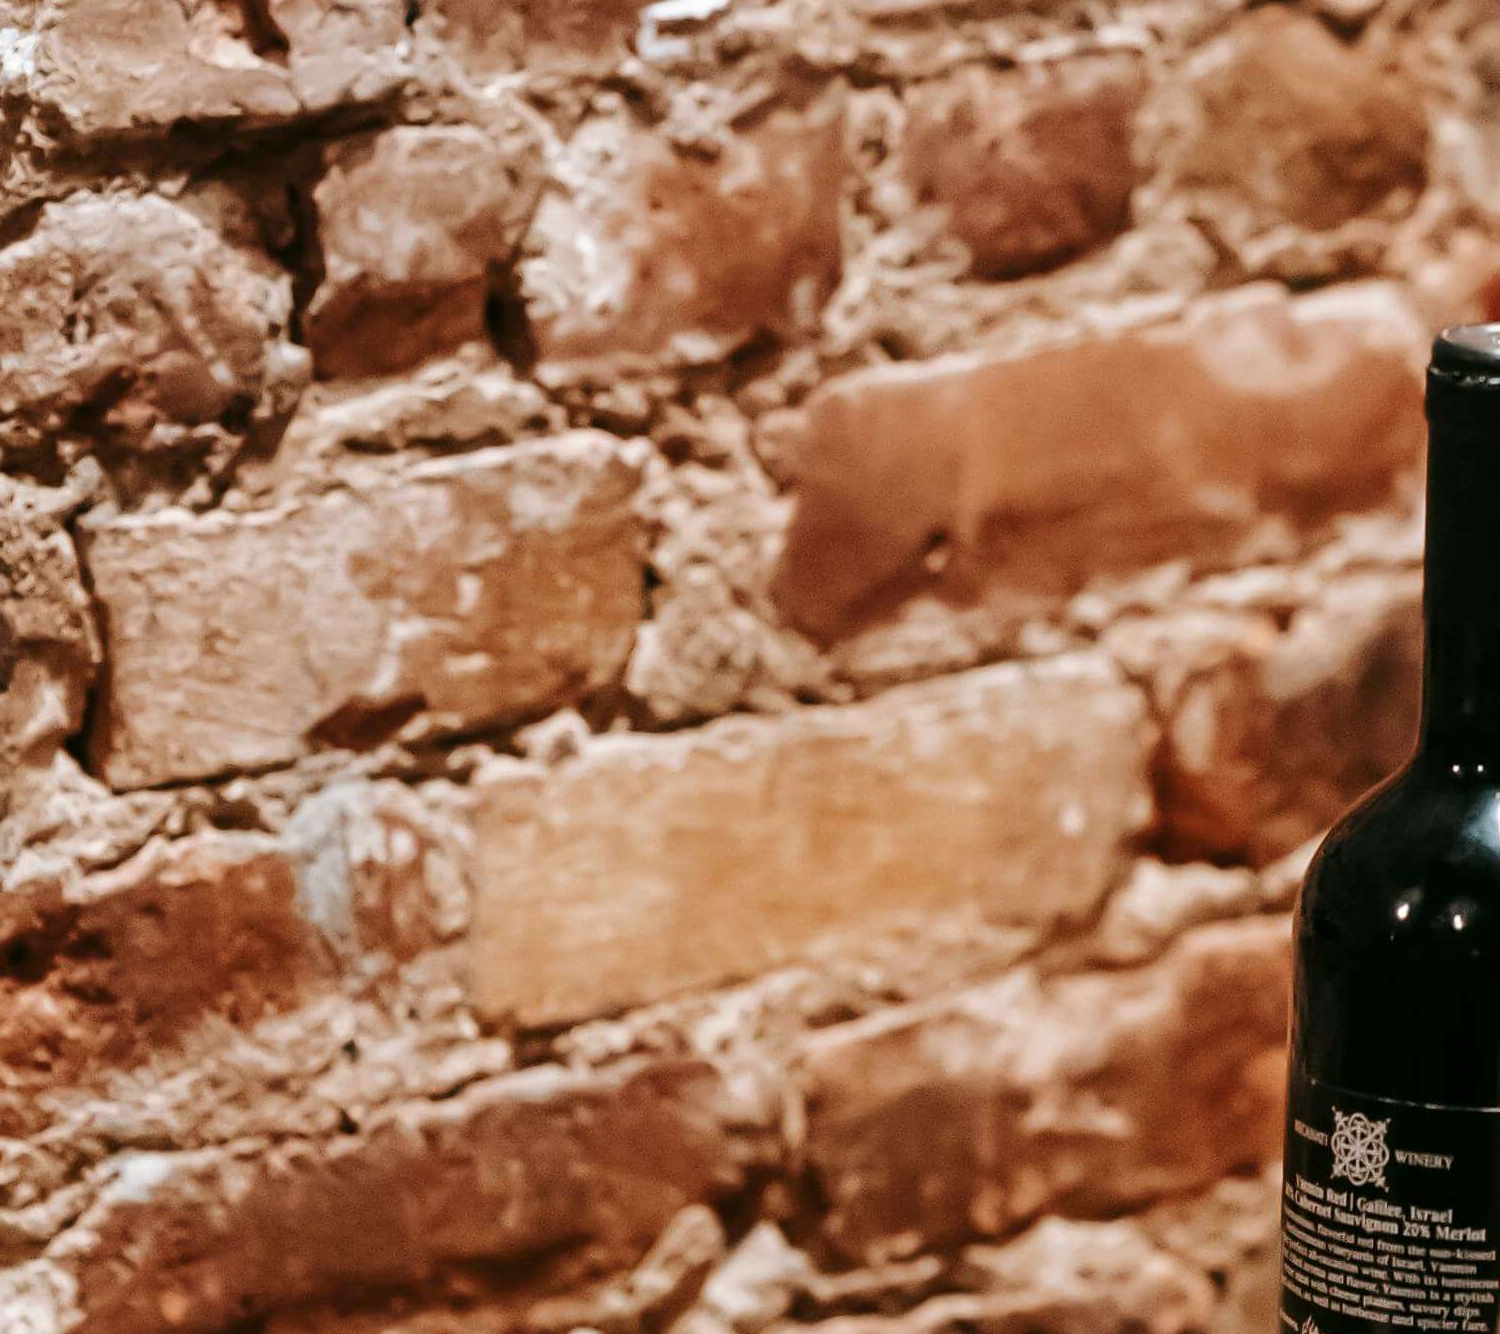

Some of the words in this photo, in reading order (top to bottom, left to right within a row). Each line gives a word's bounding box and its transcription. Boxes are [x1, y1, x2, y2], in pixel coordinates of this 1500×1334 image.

[1396, 1149, 1453, 1169] WINERY
[1410, 1205, 1453, 1224] Israel
[1403, 1222, 1431, 1239] 20%
[1435, 1225, 1487, 1243] Merlot
